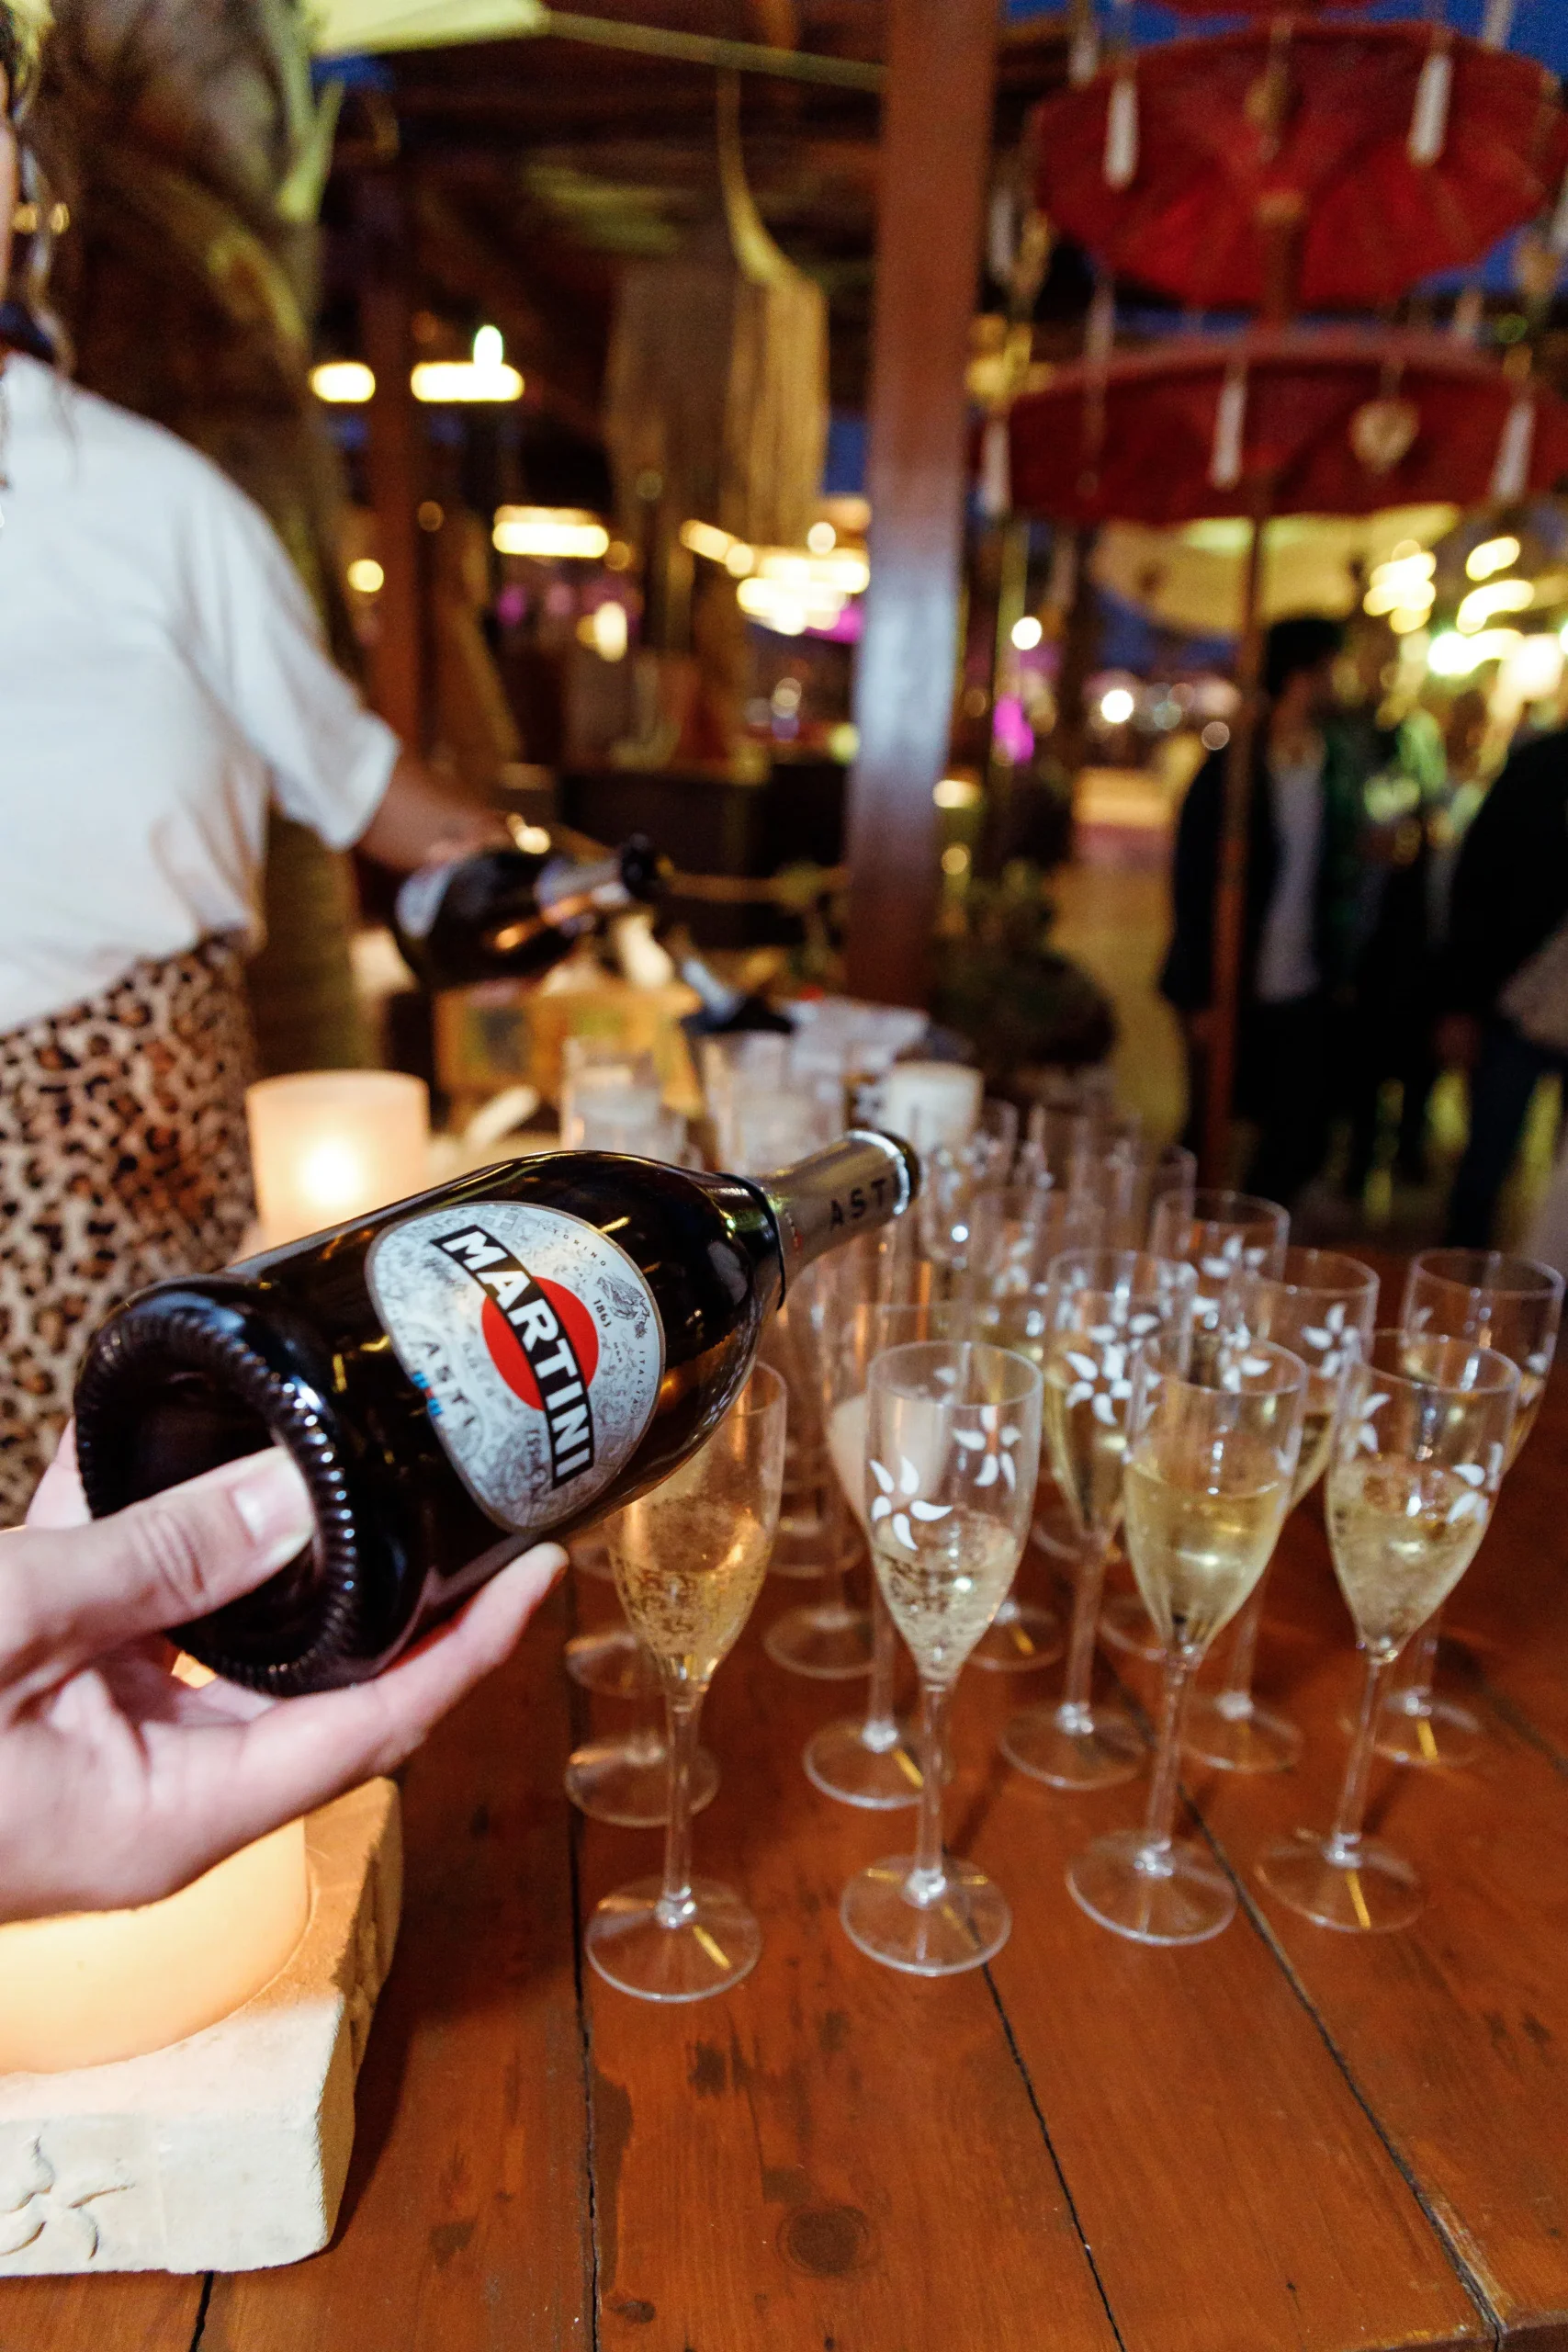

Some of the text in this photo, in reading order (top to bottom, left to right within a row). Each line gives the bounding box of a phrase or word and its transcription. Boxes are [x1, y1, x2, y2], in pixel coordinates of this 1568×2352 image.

[553, 1228, 606, 1266] TORINO
[593, 1299, 612, 1328] 1863
[446, 1231, 592, 1477] MARTINI
[634, 1351, 646, 1404] ITALIA
[422, 1341, 475, 1427] ASTI
